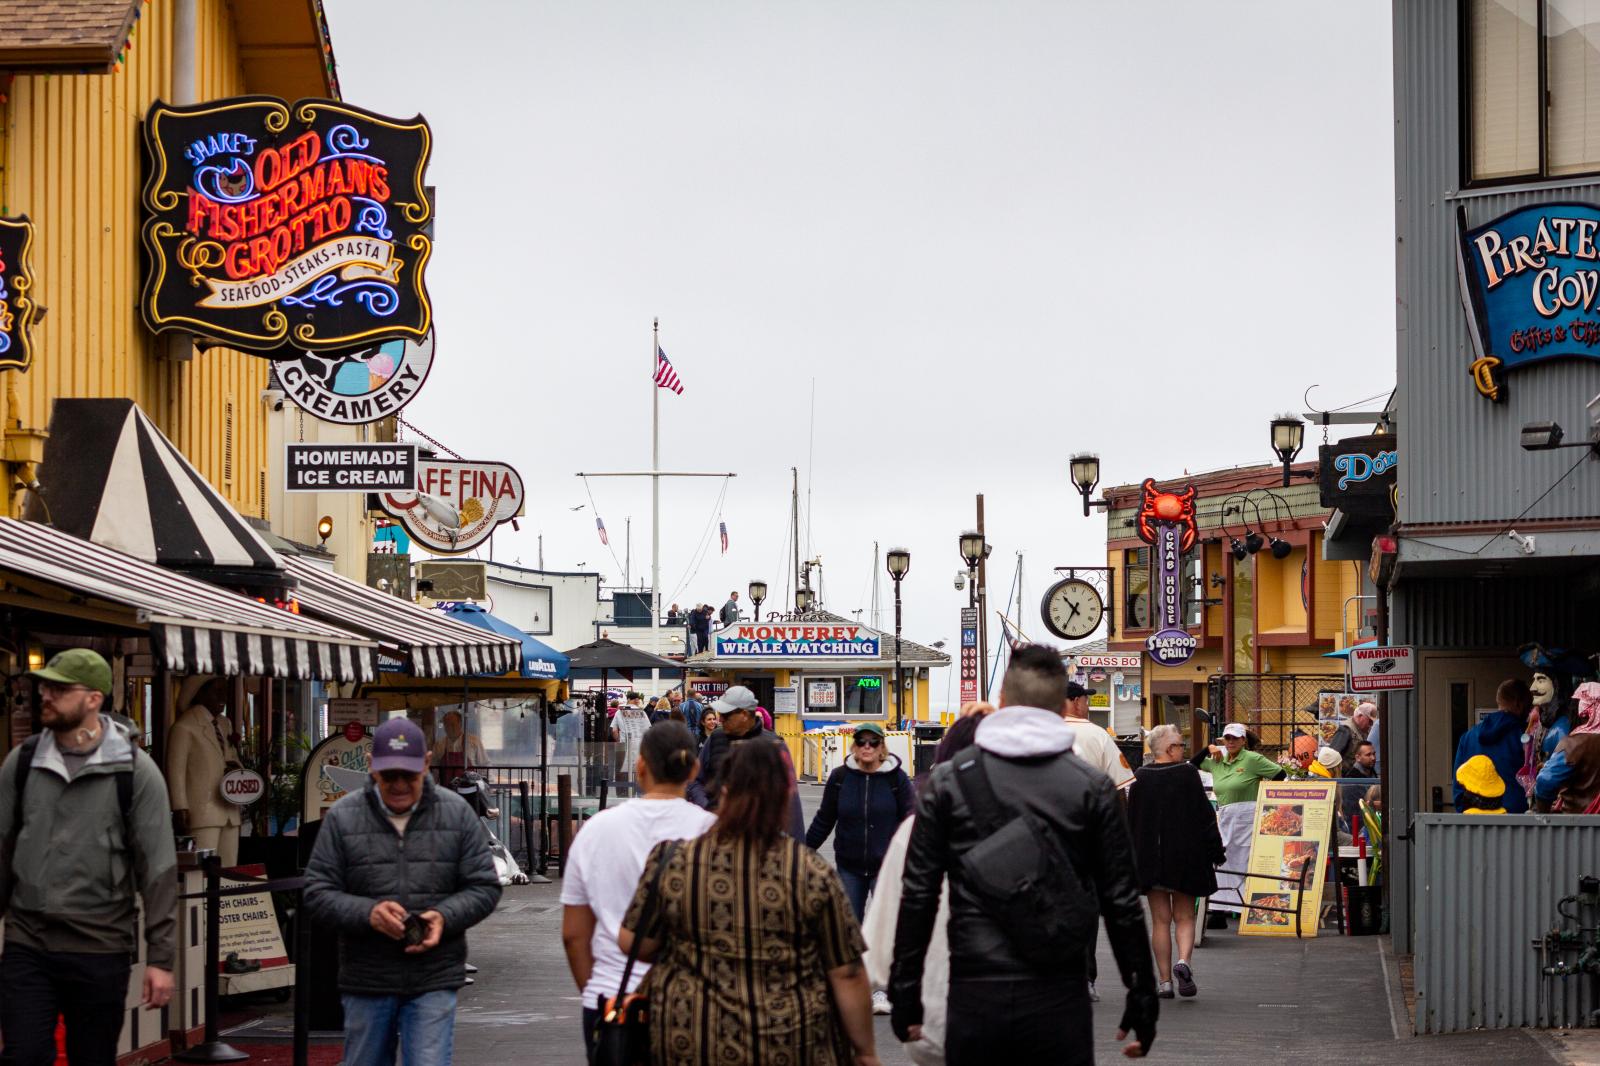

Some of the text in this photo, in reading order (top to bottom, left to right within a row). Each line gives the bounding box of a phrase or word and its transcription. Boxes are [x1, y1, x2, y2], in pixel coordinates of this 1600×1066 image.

[255, 130, 321, 192] OLD
[186, 158, 391, 241] FISHERMAN'S
[224, 195, 352, 280] GROTTO
[1474, 217, 1600, 289] PIRATE
[1532, 267, 1600, 317] COV
[283, 363, 421, 420] CREAMERY
[294, 450, 408, 465] HOMEMADE
[297, 470, 405, 485] ICE CREAM
[459, 469, 516, 510] FINA
[1166, 531, 1176, 624] CRAB HOUSE
[766, 611, 831, 623] Princess
[738, 627, 860, 640] MONTEREY
[722, 643, 874, 654] WHALE WATCHING
[1148, 635, 1197, 651] SEAFOOD
[1080, 656, 1118, 666] GLASS
[1158, 647, 1188, 661] GRILL
[1356, 648, 1409, 660] WARNING
[692, 683, 729, 692] NEXT TRIP
[857, 678, 881, 687] ATM
[1354, 678, 1413, 688] VIDEO SURVEILLANCE
[226, 779, 260, 794] CLOSED
[233, 896, 258, 908] CHAIRS
[242, 910, 268, 921] CHAIRS
